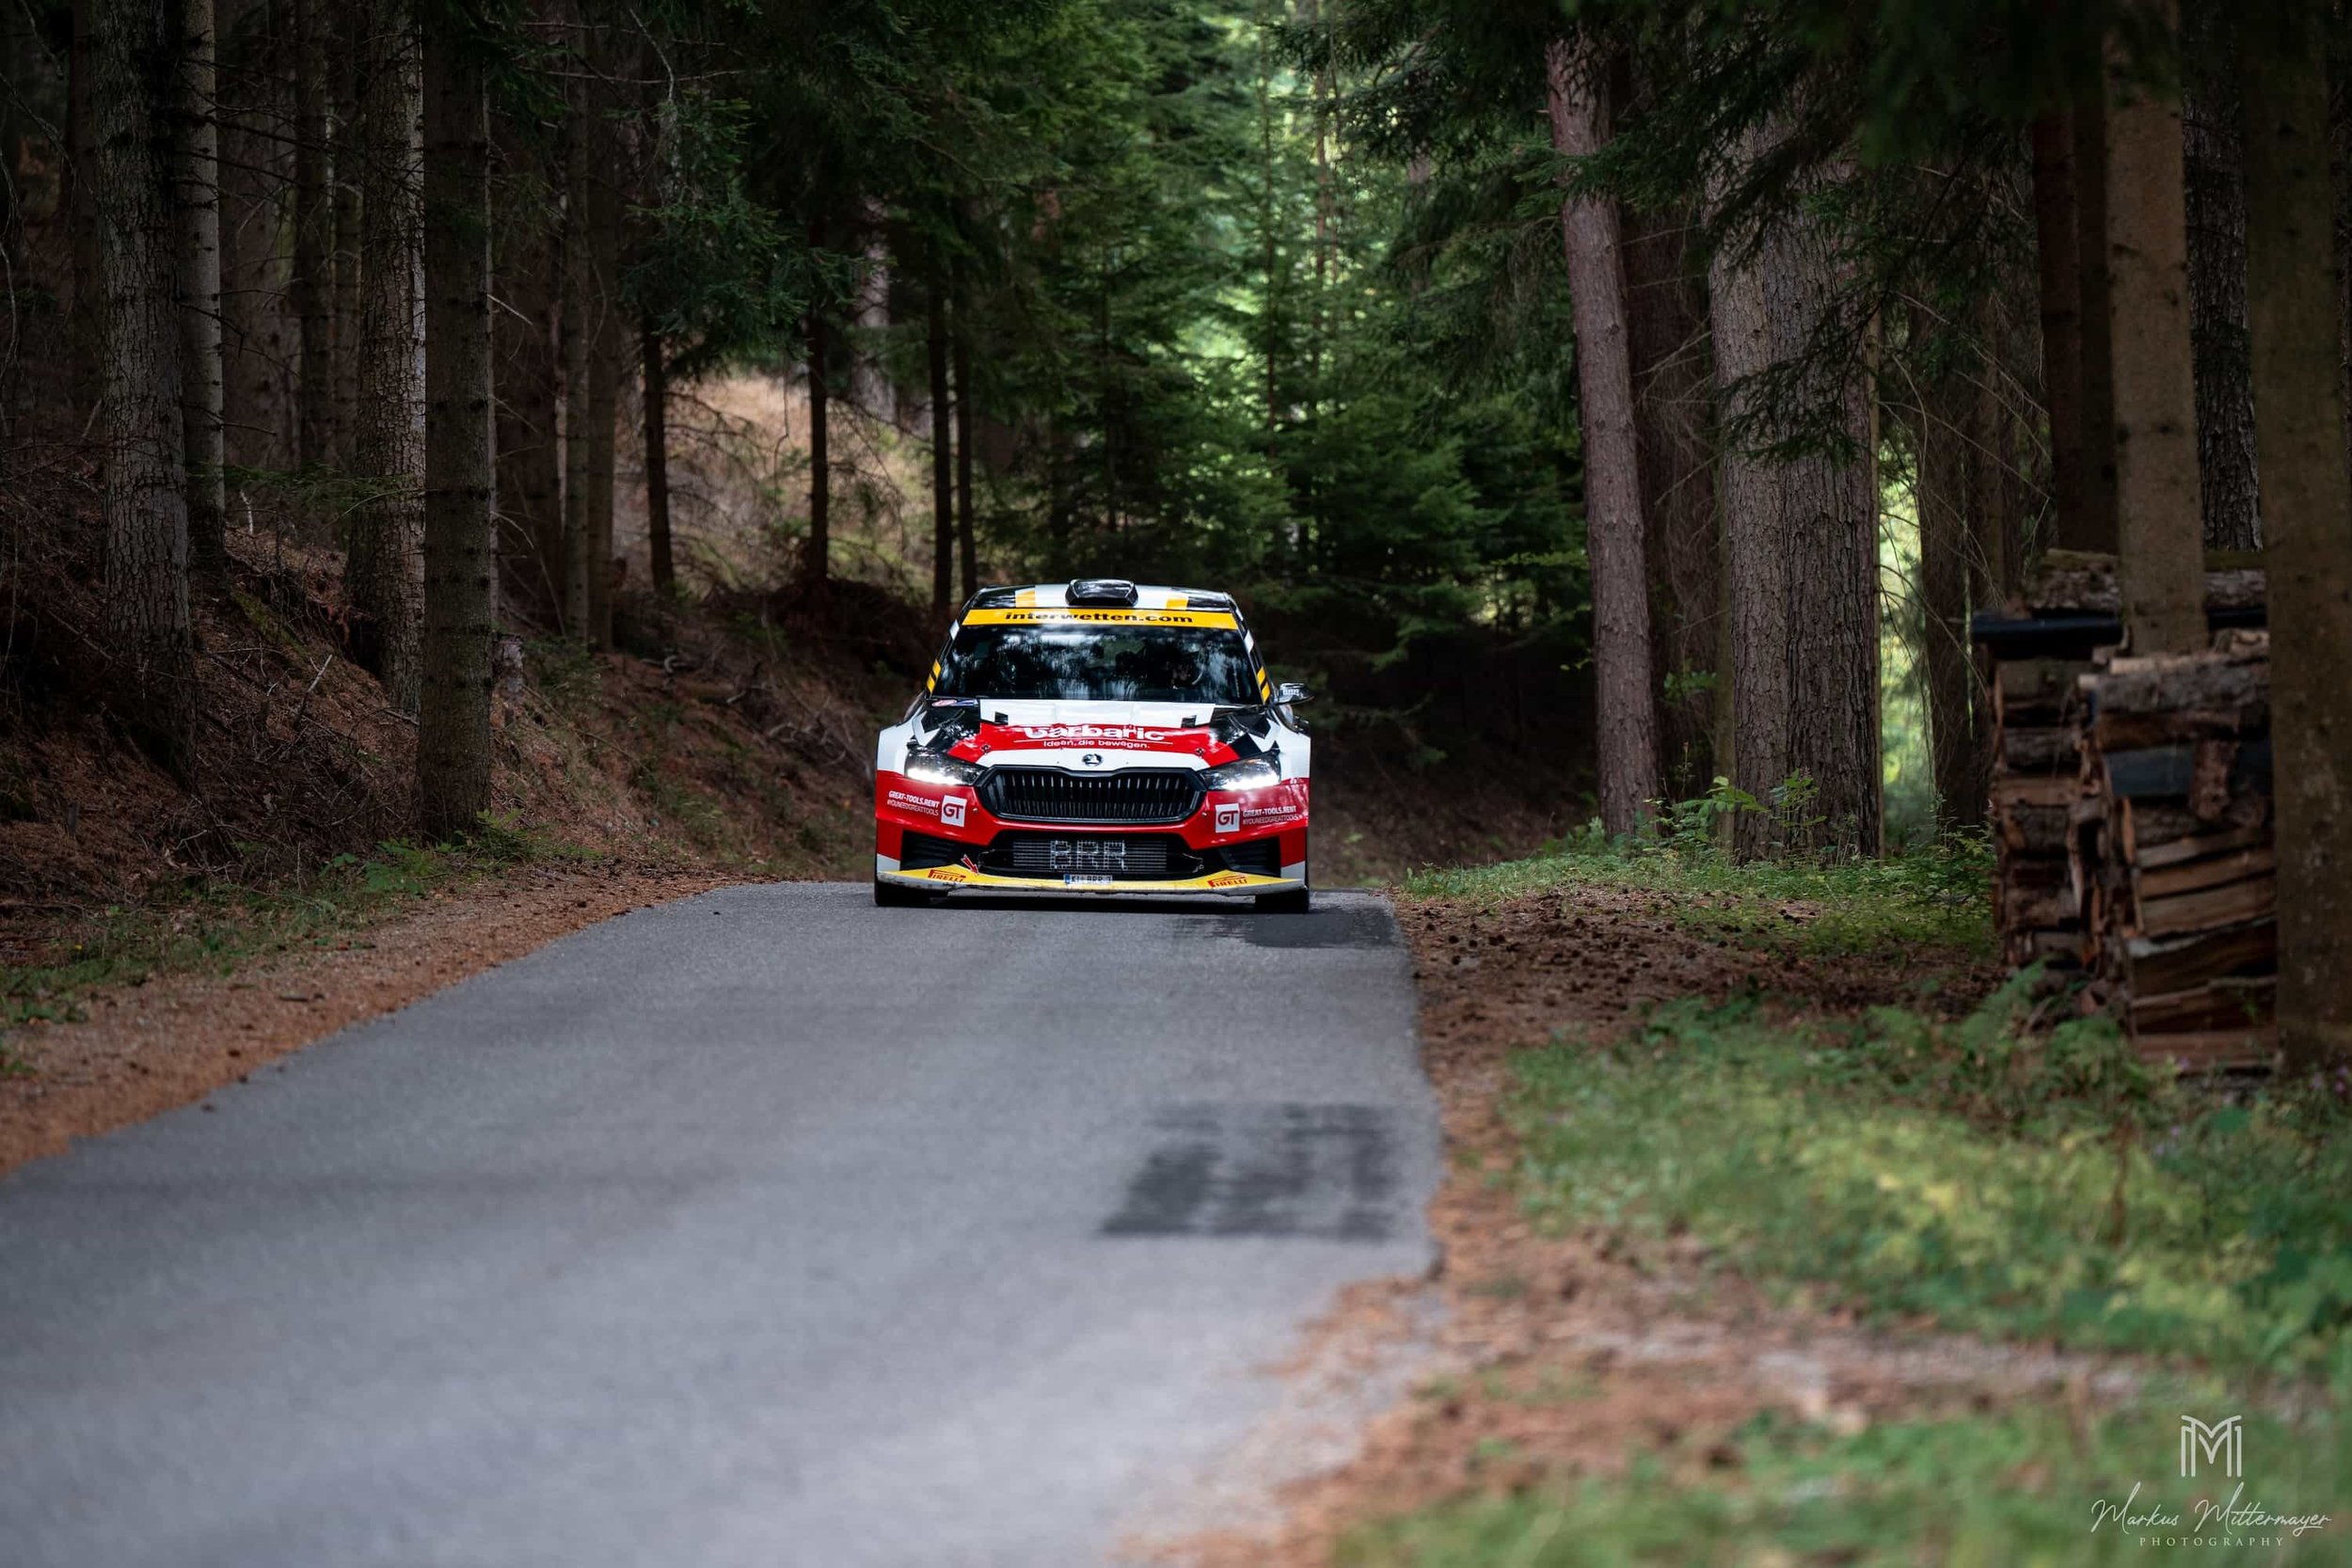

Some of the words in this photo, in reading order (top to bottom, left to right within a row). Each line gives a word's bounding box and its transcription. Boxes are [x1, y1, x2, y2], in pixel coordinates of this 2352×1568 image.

[1005, 611, 1193, 623] interwetten.com
[1098, 739, 1151, 750] bewegen.
[888, 790, 940, 808] GREAT-TOOLS.RENT
[944, 802, 963, 819] GT
[1243, 805, 1296, 817] GREAT-TOOLS.RENT
[1217, 810, 1238, 826] GT
[1050, 840, 1128, 871] BRR
[928, 869, 966, 882] PIRELLI
[1207, 875, 1248, 887] PIRELLI
